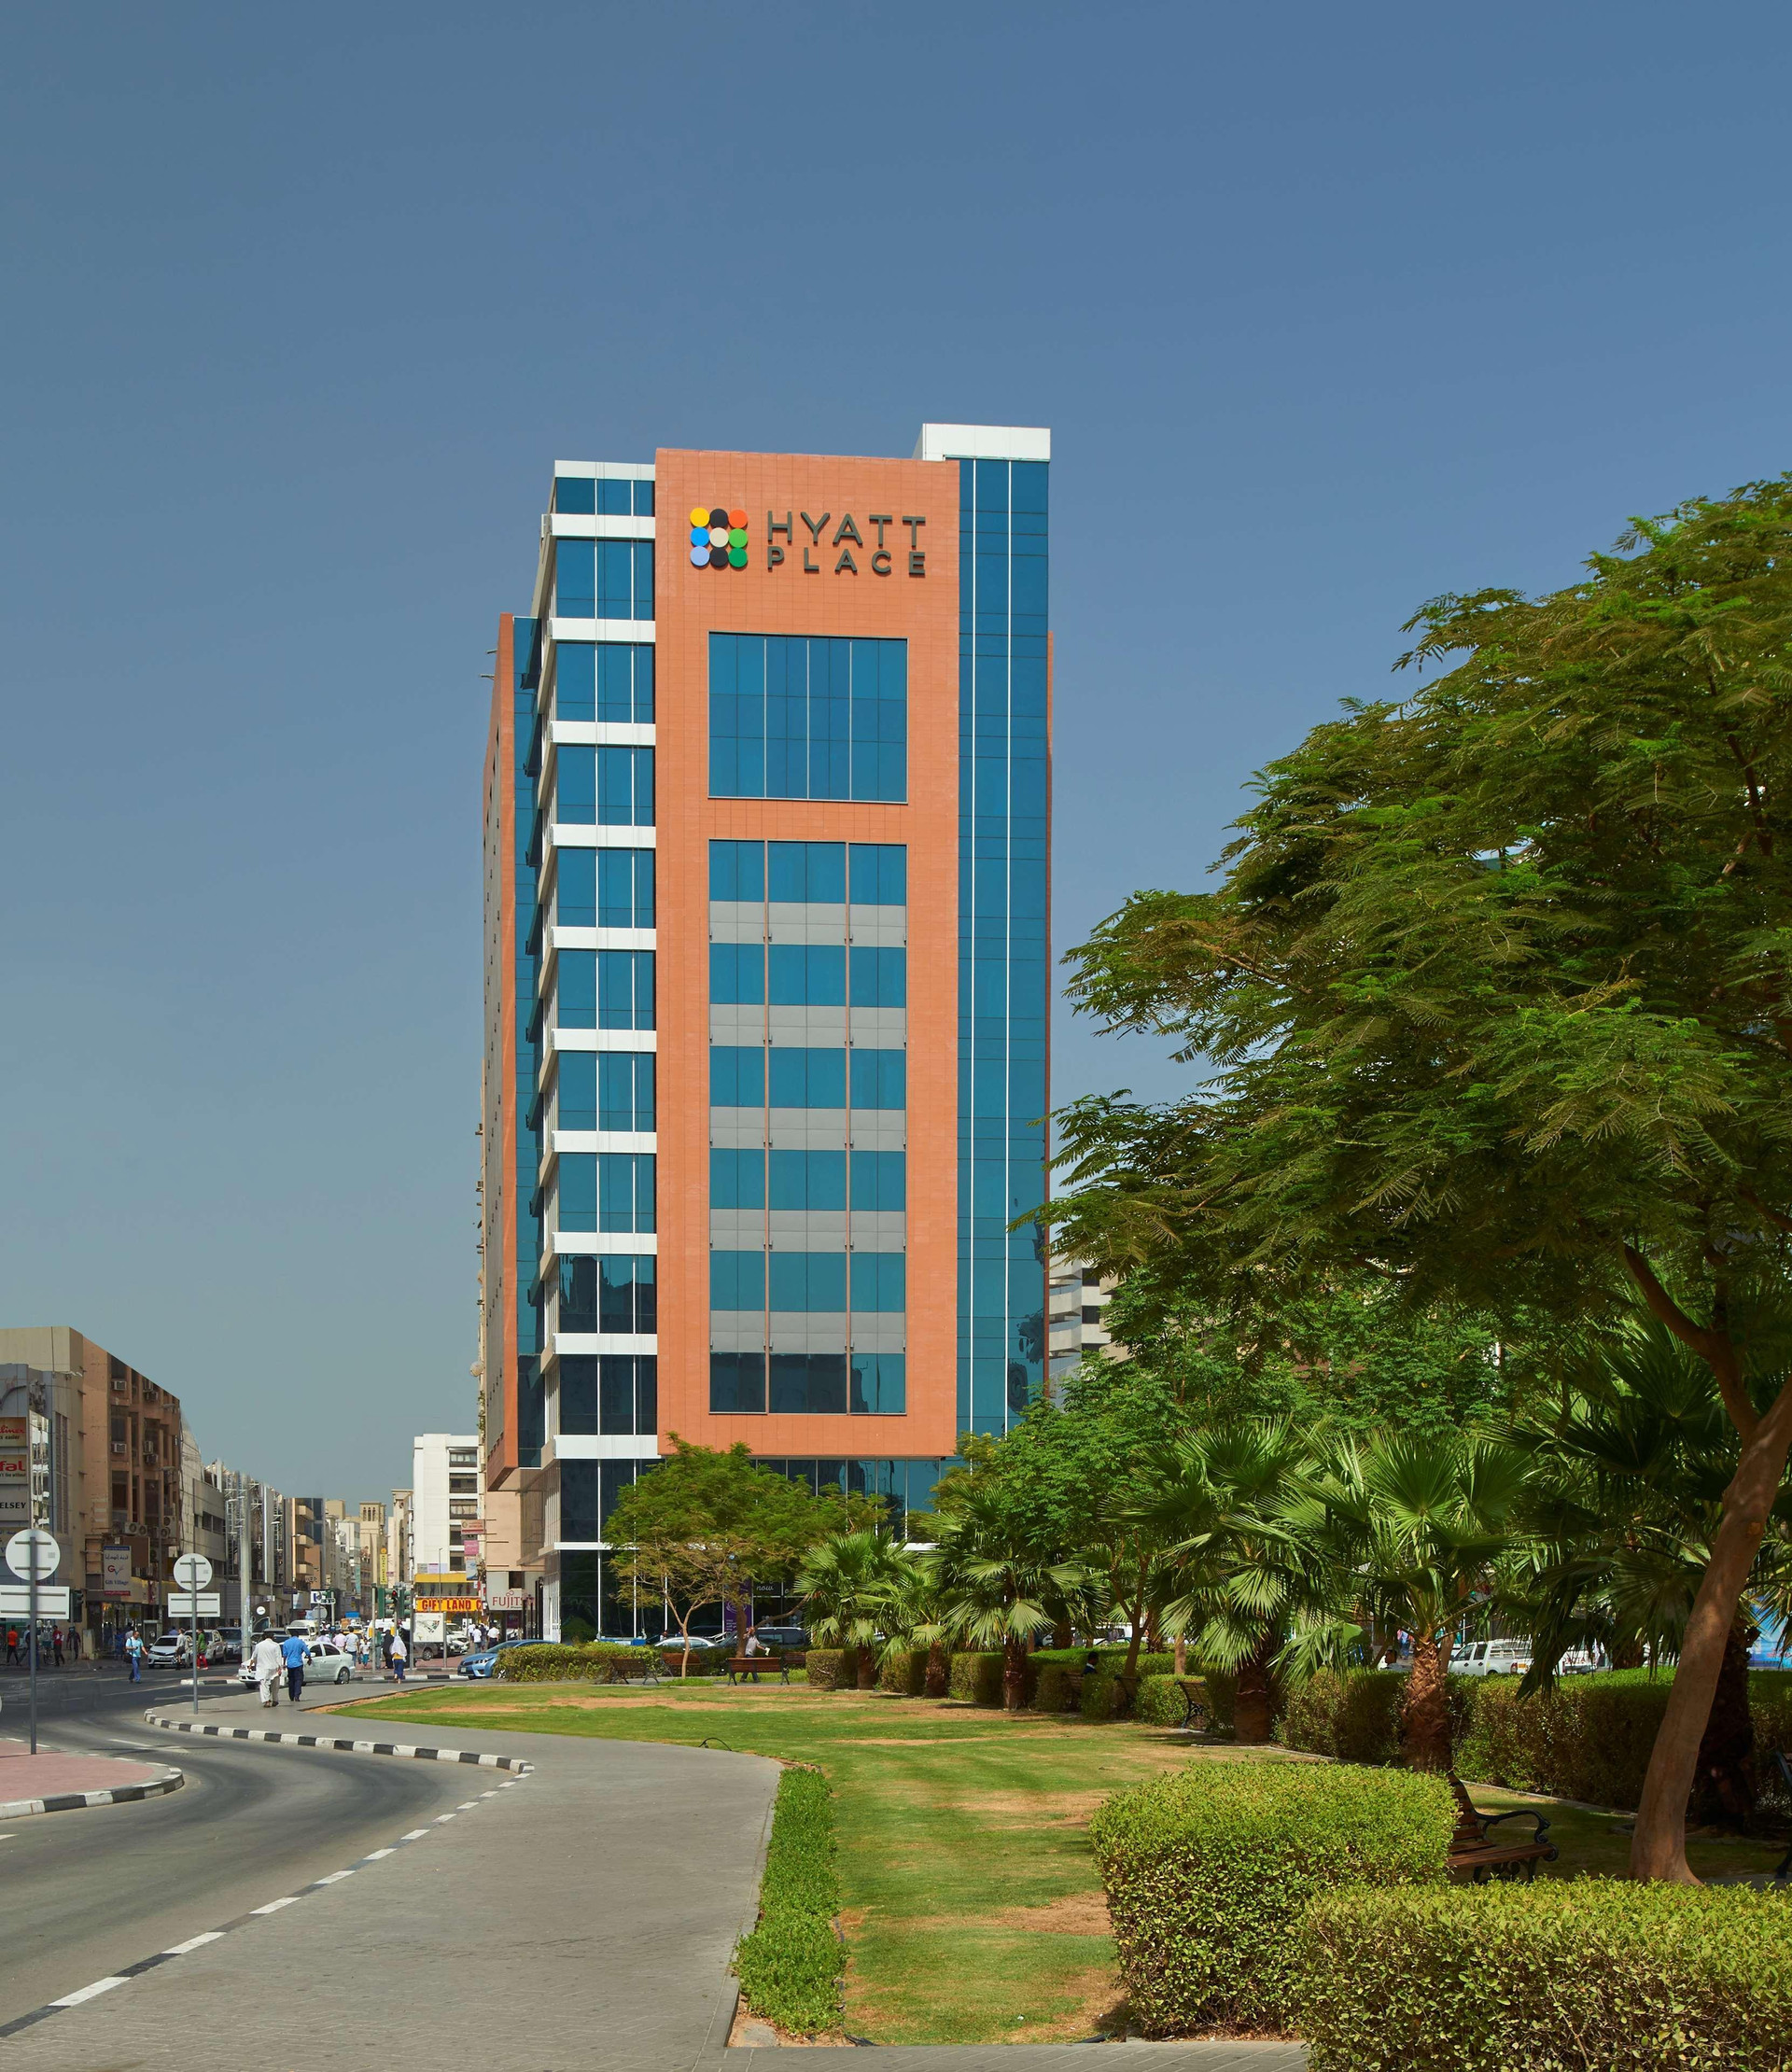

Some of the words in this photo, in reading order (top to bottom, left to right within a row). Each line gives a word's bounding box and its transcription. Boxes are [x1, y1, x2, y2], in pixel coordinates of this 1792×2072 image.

[767, 511, 926, 549] HYATT
[767, 546, 926, 577] PLACE
[422, 1599, 442, 1610] GIFT
[447, 1599, 471, 1610] LAND
[492, 1596, 535, 1608] FUJIT
